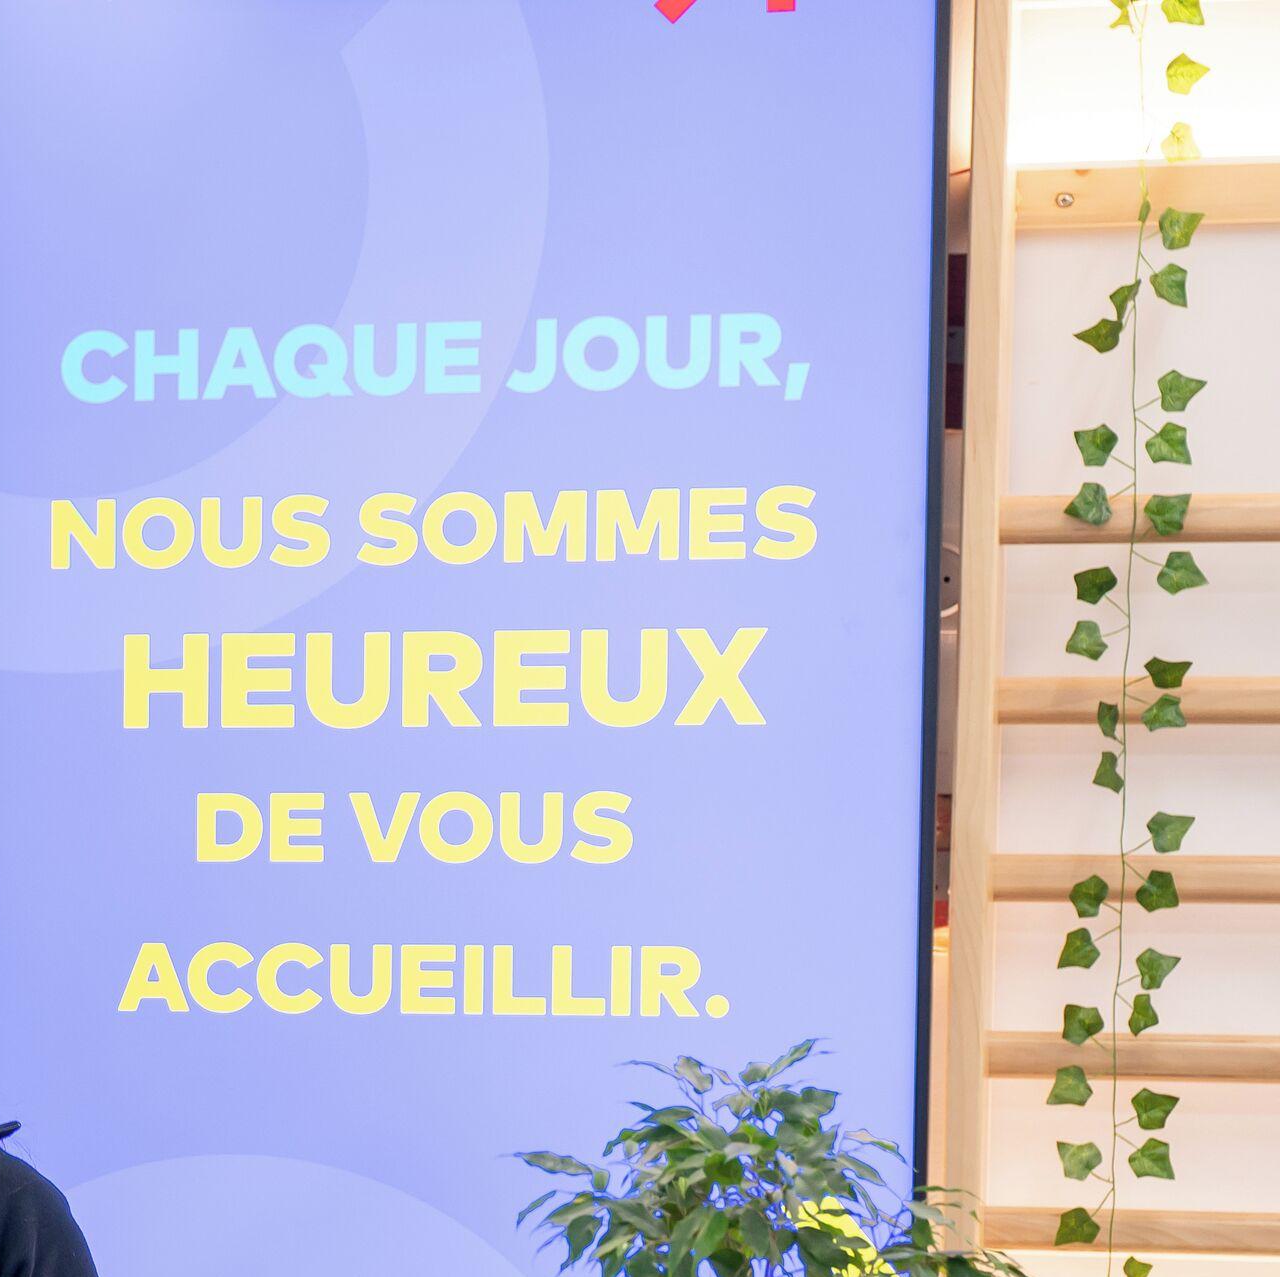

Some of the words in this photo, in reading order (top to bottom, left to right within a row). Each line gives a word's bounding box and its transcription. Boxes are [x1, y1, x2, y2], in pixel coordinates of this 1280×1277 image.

[61, 321, 482, 404] CHAQUE
[506, 312, 810, 401] JOUR,
[50, 495, 331, 570] NOUS
[357, 484, 818, 567] SOMMES
[122, 627, 767, 730] HEUREUX
[196, 792, 326, 864] DE
[349, 790, 634, 864] VOUS
[117, 940, 730, 1018] ACCUEILLIR.
